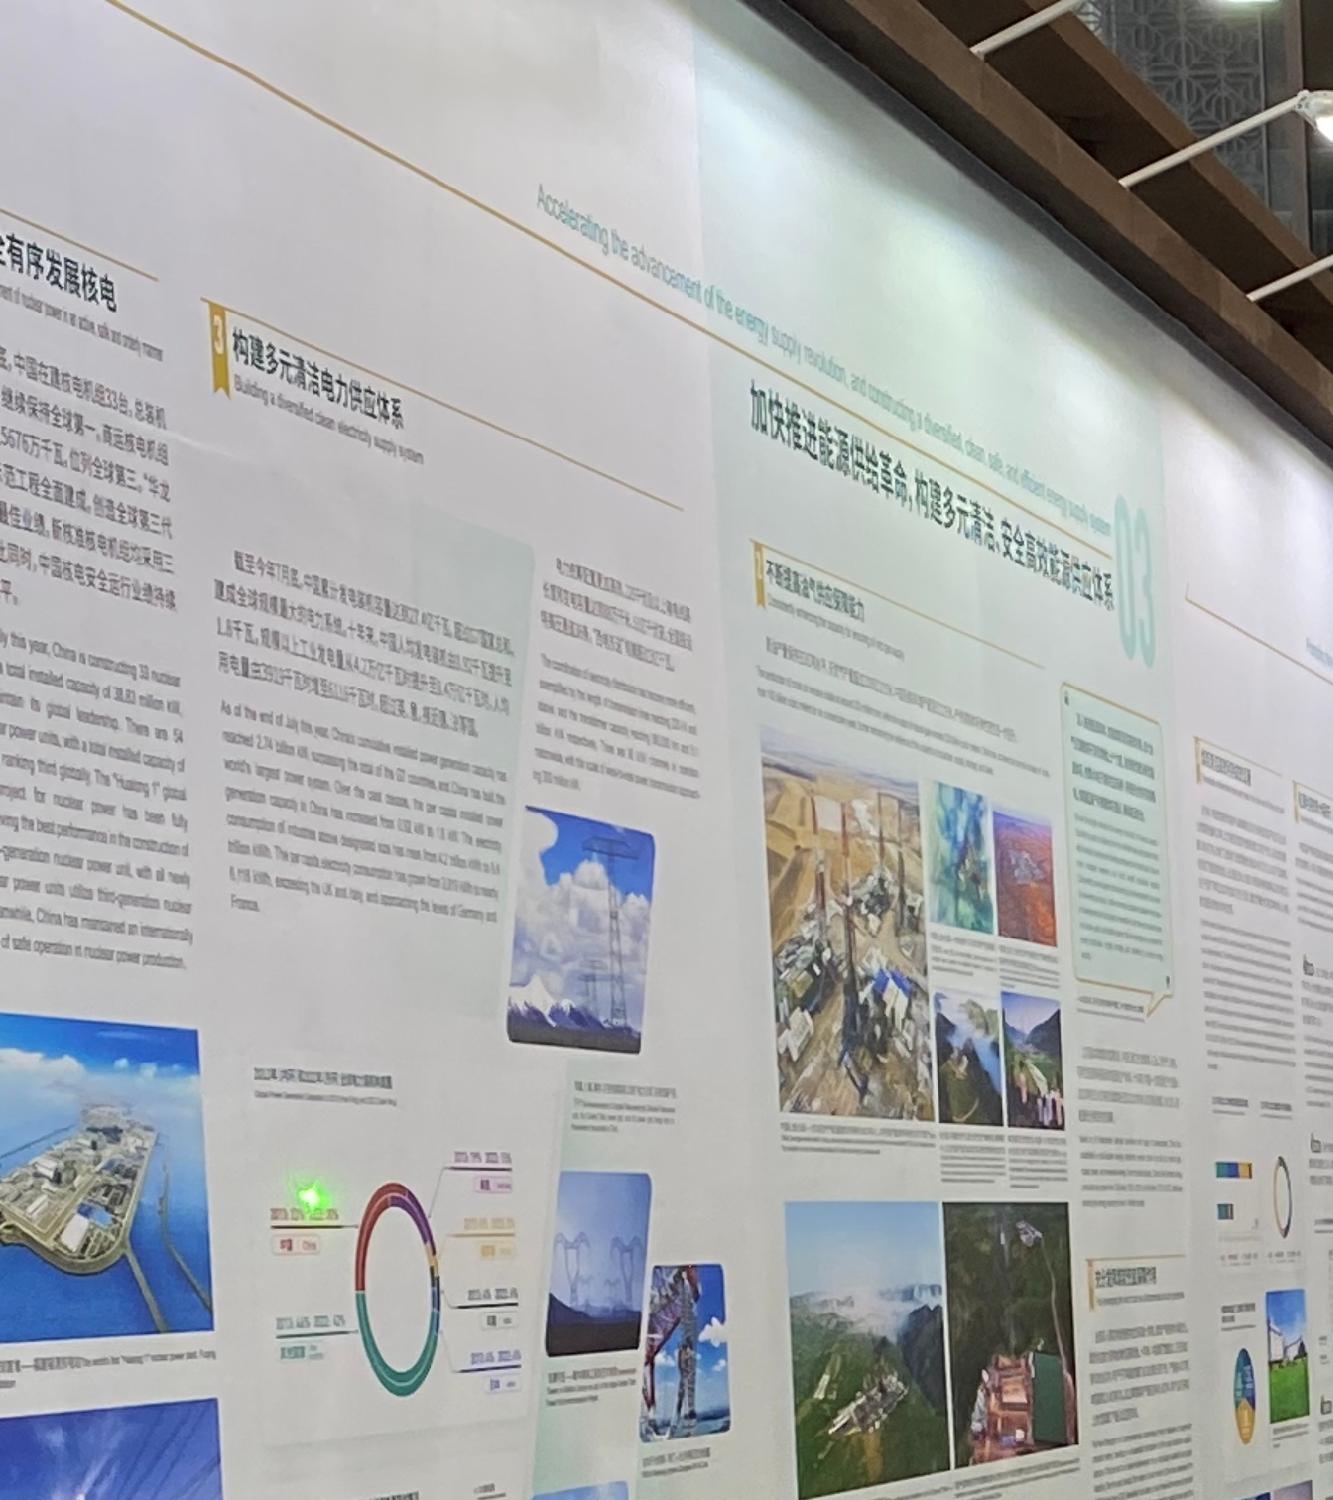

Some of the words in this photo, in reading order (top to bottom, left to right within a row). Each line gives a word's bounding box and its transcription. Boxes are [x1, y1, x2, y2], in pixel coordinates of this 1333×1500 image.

[537, 182, 608, 259] Accelerating
[611, 226, 629, 263] the
[630, 237, 701, 305] advancement
[703, 281, 713, 312] of
[714, 287, 733, 323] the
[734, 305, 768, 349] energy
[232, 325, 404, 433] 构建多元清洁电力供应体系
[234, 373, 268, 407] Building
[0, 462, 173, 540] 范工程全面建成，创造全球第三代
[1116, 495, 1156, 669] 03
[0, 844, 50, 867] -generation
